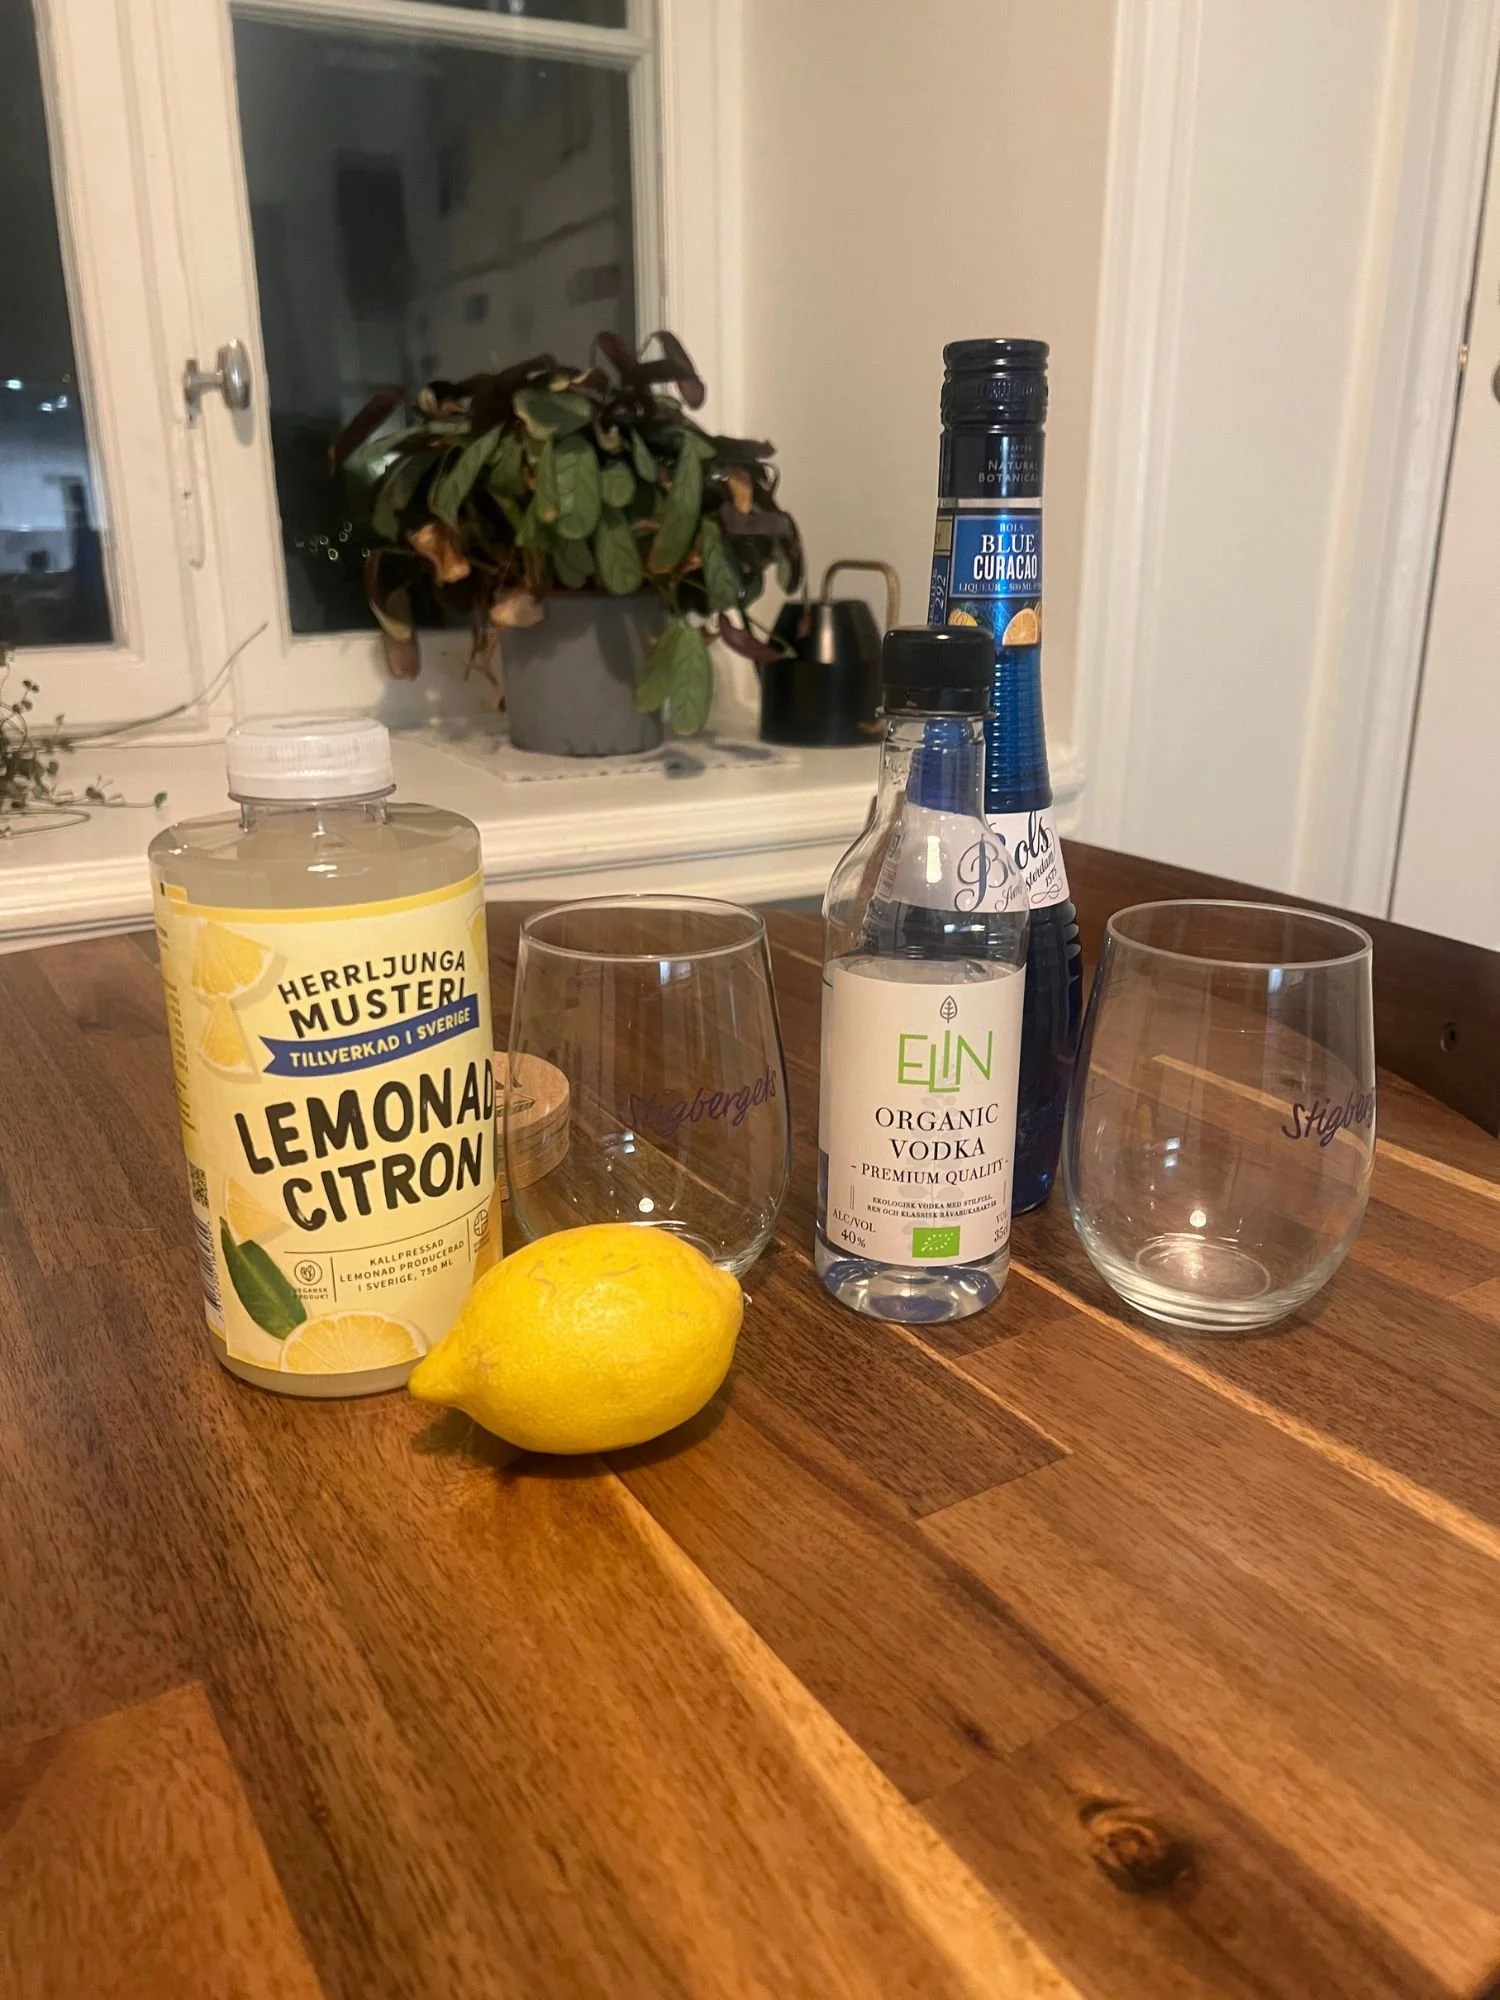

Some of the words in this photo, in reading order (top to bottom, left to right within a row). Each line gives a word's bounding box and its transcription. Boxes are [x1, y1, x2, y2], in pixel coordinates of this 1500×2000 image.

[999, 523, 1024, 532] BOLS
[981, 534, 1035, 553] BLUE
[973, 554, 1038, 580] CURACAO
[277, 950, 465, 1005] HERRLJUNGA
[288, 977, 465, 1039] MUSTERI
[289, 1035, 400, 1068] TILLVERKAD
[405, 1030, 412, 1045] I
[417, 1008, 471, 1040] SVERIGE
[898, 1030, 993, 1093] ELIN
[234, 1058, 494, 1174] LEMONAD
[875, 1103, 999, 1132] ORGANIC
[889, 1137, 986, 1161] VODKA
[282, 1132, 483, 1232] CITRON
[862, 1162, 940, 1185] PREMIUM
[945, 1159, 1004, 1186] QUALITY
[872, 1196, 916, 1210] EKOLOGISK
[918, 1202, 945, 1210] VODKA
[946, 1200, 962, 1209] MED
[901, 1210, 938, 1219] KLASSISK
[832, 1209, 876, 1233] ALC/VOL
[339, 1266, 396, 1283] LEMONAD
[400, 1240, 465, 1272] PRODUCERAD
[370, 1238, 445, 1267] KALLPRESSAD
[357, 1284, 362, 1292] I
[366, 1274, 418, 1292] SVERIGE,
[421, 1265, 438, 1278] 750
[441, 1258, 454, 1270] ML
